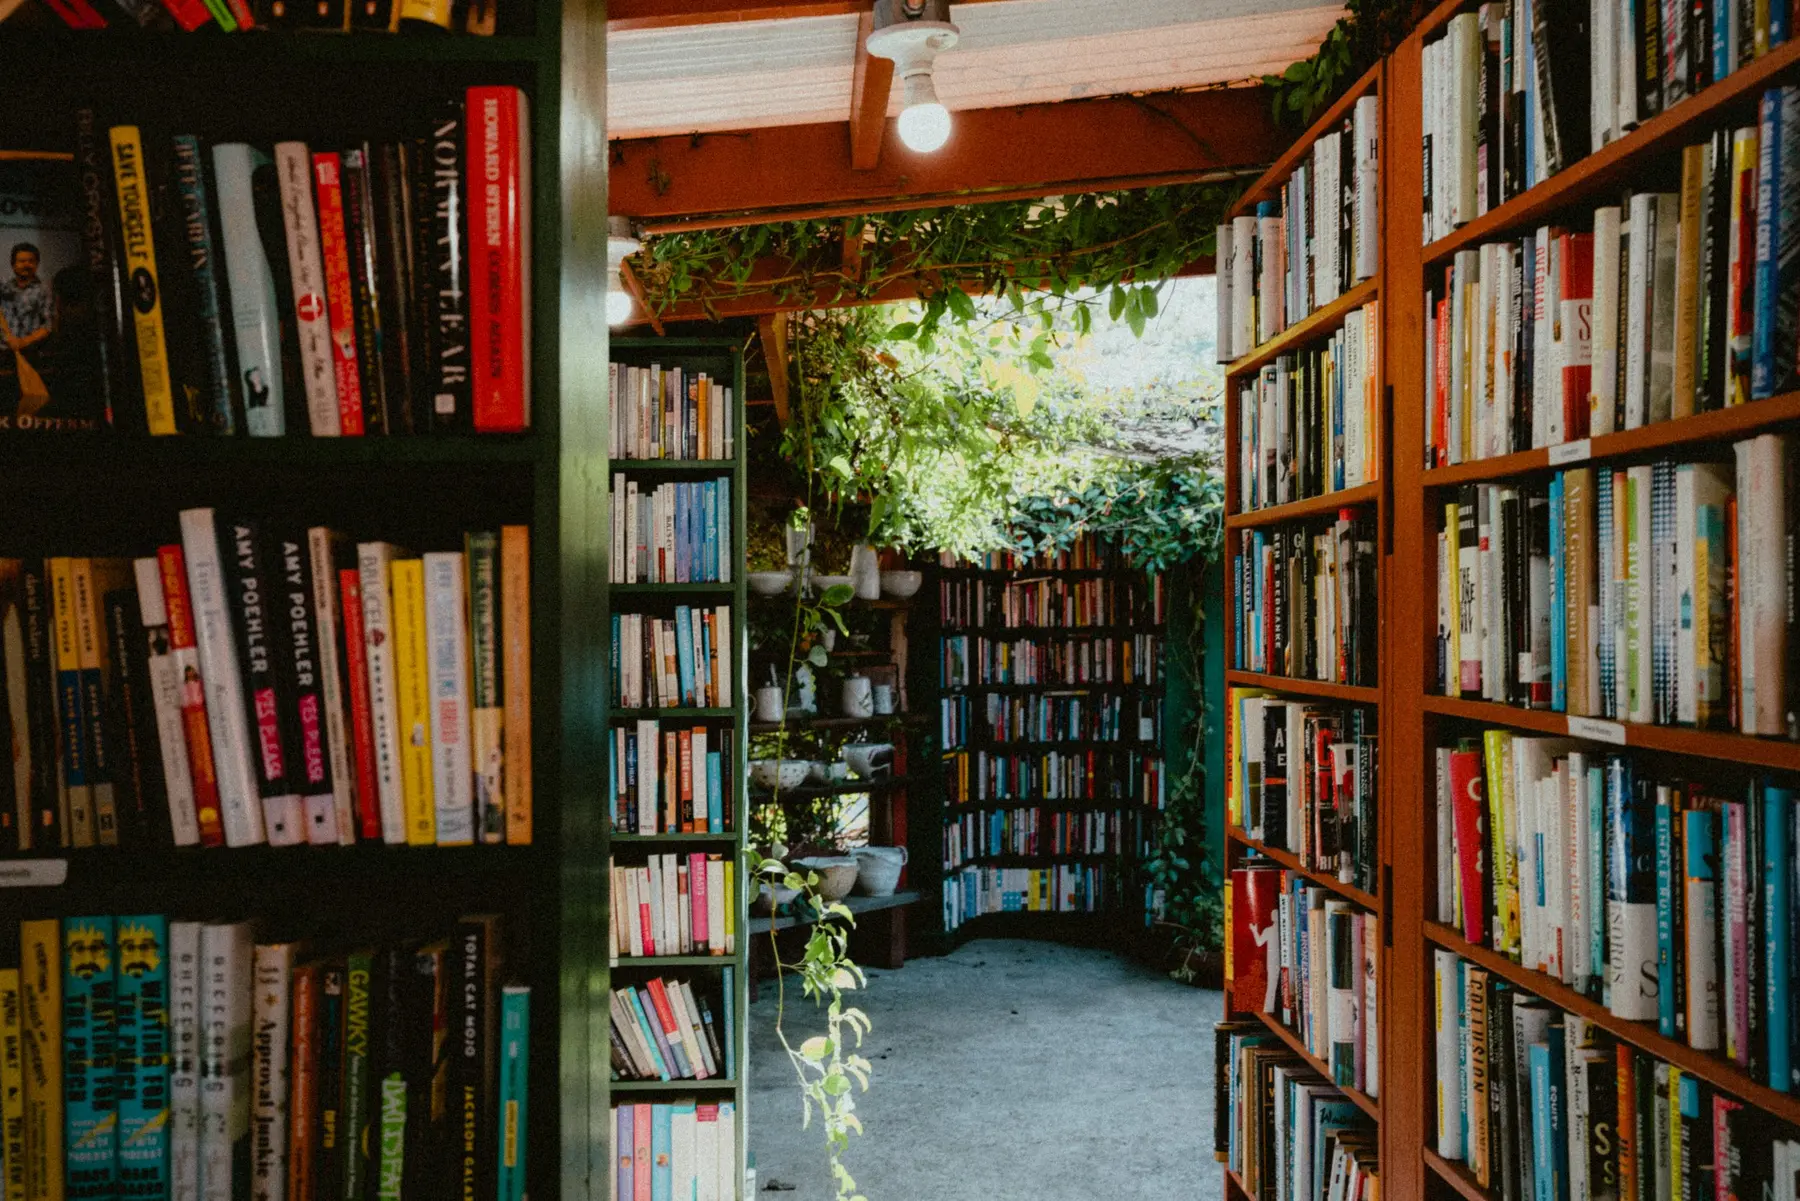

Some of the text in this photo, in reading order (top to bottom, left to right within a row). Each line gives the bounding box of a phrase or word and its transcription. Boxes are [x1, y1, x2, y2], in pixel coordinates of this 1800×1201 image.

[77, 109, 104, 272] BILLY CRYSTAL
[117, 144, 147, 260] SAVE YOURSELF
[175, 143, 207, 269] JEFF GARLIN
[483, 98, 502, 247] HOWARD STERN
[432, 119, 466, 386] NORMAN LEAR
[1534, 247, 1546, 320] OVERHAUL
[346, 359, 358, 412] CHELSEA
[58, 576, 72, 653] BARREL FEVER
[77, 575, 93, 652] BARREL FEVER
[234, 525, 267, 673] AMY POEHLER
[282, 541, 313, 686] AMY POEHLER
[1567, 486, 1581, 638] Alan Greenspan
[1628, 542, 1640, 611] GIVING
[256, 688, 282, 780] YES PLEASE
[298, 694, 325, 782] YES PLEASE
[696, 861, 704, 895] BREASTS
[1568, 777, 1580, 921] DISRUPTING CLASS
[1658, 817, 1669, 940] SIMPLE RULES
[1611, 913, 1624, 984] SOROS
[1747, 892, 1756, 921] ONE
[1766, 883, 1776, 1014] Better Together
[67, 993, 87, 1101] THE PUNCH
[91, 981, 115, 1110] WAITING FOR
[117, 993, 136, 1100] THE PUNCH
[141, 980, 163, 1109] WAITING FOR
[347, 969, 369, 1057] GAWKY
[464, 934, 477, 1057] TOTAL CAT MOJO
[1471, 979, 1485, 1093] COLLUSION
[1516, 1015, 1525, 1068] LESSONS
[1748, 983, 1757, 1028] AHEAD
[255, 1019, 277, 1179] Approval Junkie
[379, 1080, 406, 1201] DAD IS FAT
[463, 1086, 476, 1151] JACKSON
[1459, 1065, 1468, 1112] Together
[1550, 1085, 1558, 1130] EQUITY
